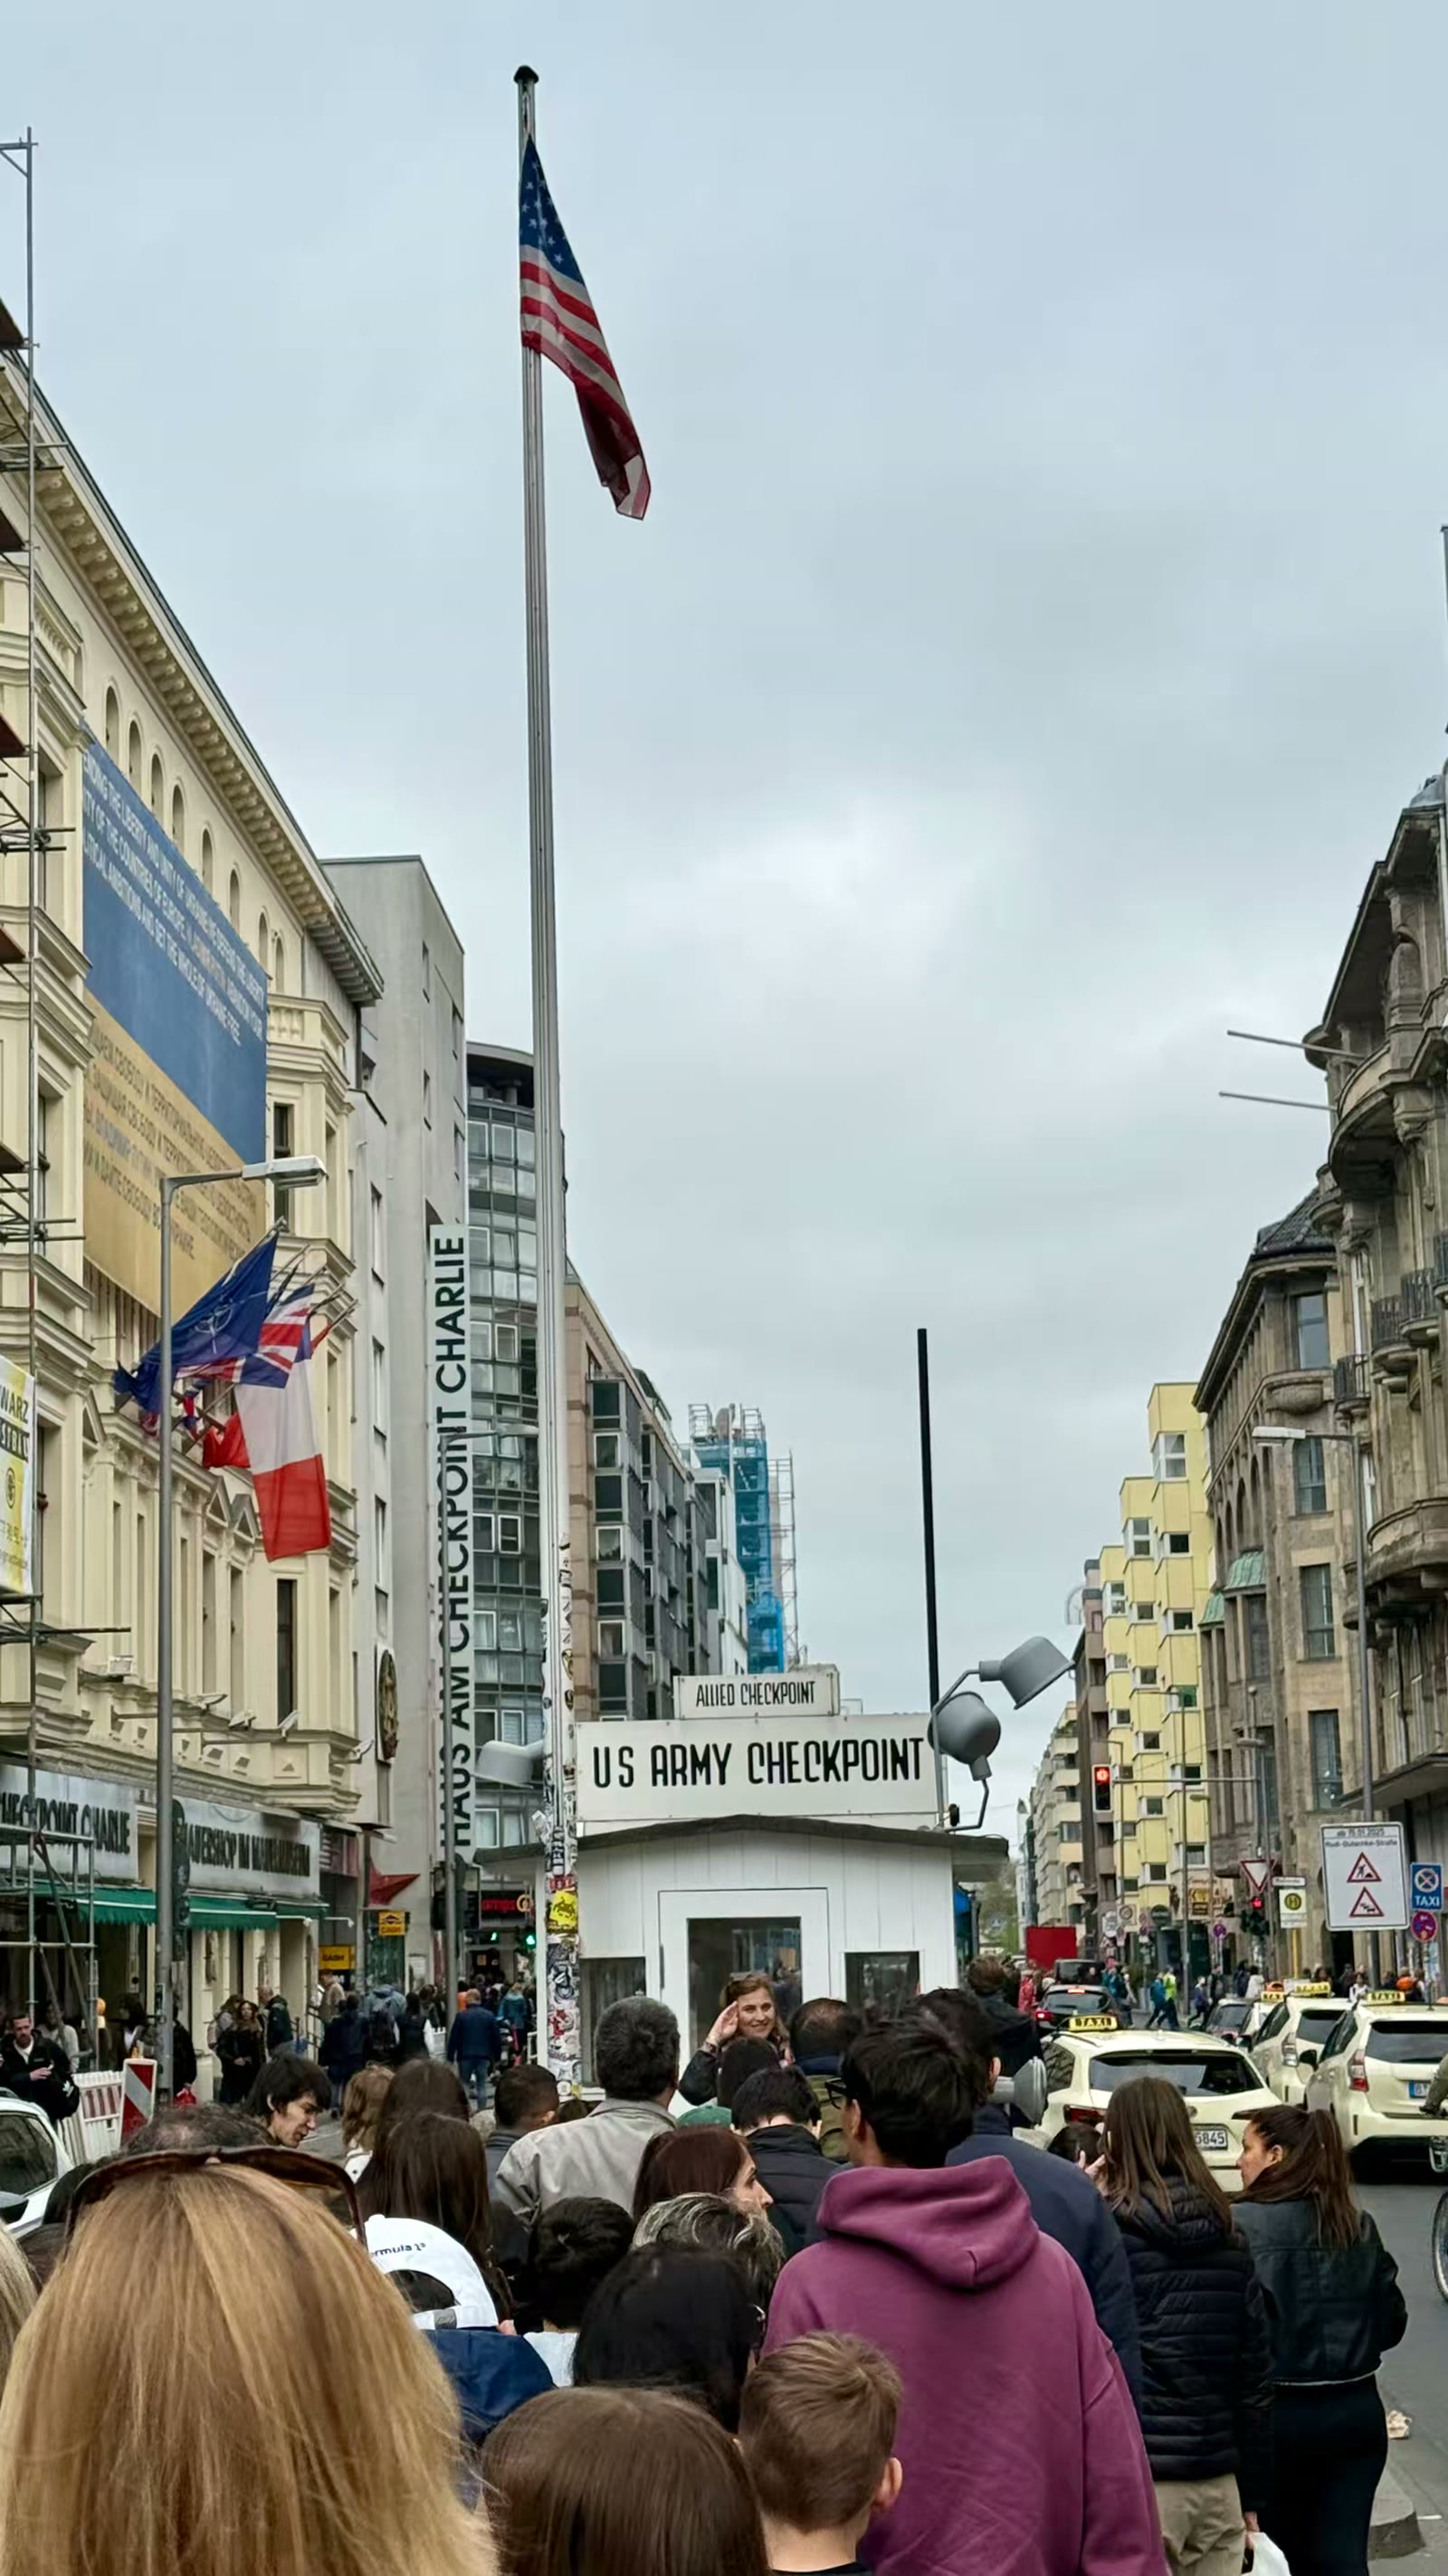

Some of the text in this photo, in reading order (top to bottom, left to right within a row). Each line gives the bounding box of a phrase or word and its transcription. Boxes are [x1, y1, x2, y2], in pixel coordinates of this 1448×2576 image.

[434, 1237, 471, 1847] HAUS AM CHECKPOINT CHARLIE
[696, 1680, 816, 1707] ALLIED CHECKPOINT
[651, 1742, 732, 1787] ARMY
[747, 1737, 924, 1785] CHECKPOINT
[1415, 1895, 1441, 1908] TAXI
[1080, 2017, 1108, 2027] TAXI
